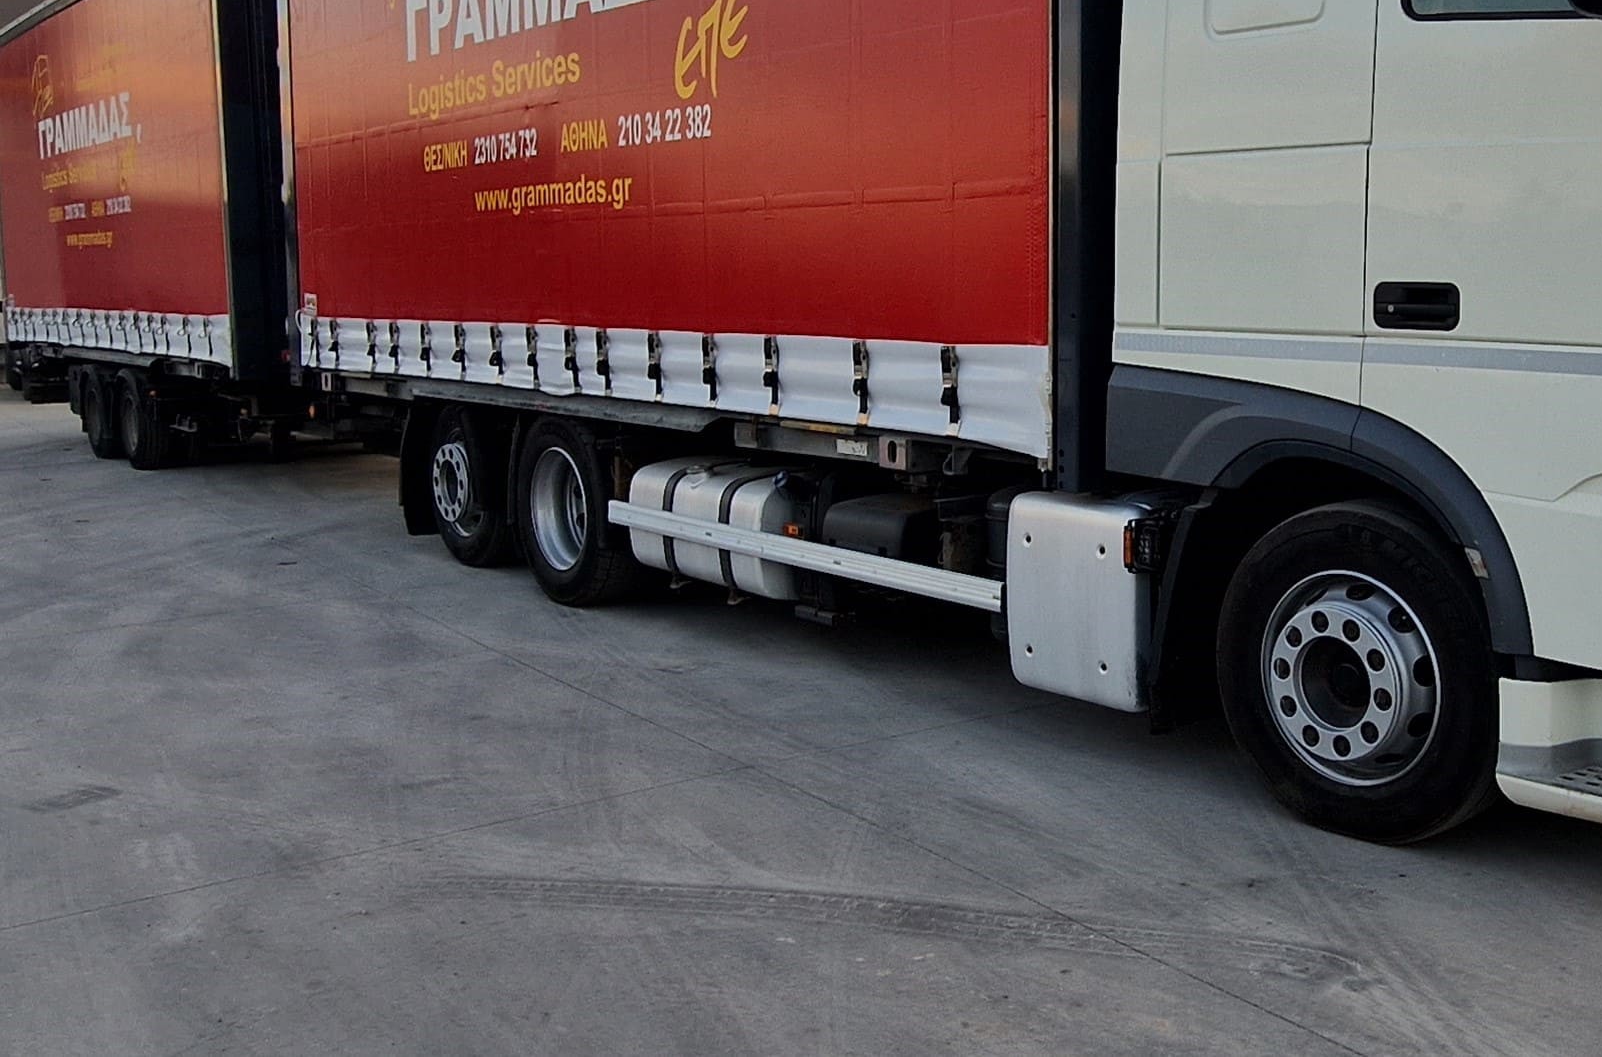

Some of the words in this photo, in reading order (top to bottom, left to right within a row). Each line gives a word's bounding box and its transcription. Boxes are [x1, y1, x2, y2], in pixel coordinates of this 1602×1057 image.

[408, 69, 487, 120] Logistics
[491, 50, 581, 97] Services
[474, 135, 497, 165] 2310
[499, 131, 517, 160] 754
[561, 118, 608, 153] ΑΘΗΝΑ
[618, 114, 641, 147] 210
[645, 110, 661, 144] 34
[665, 108, 682, 141] 22
[685, 104, 711, 139] 382
[474, 174, 632, 216] www.grammadas.gr
